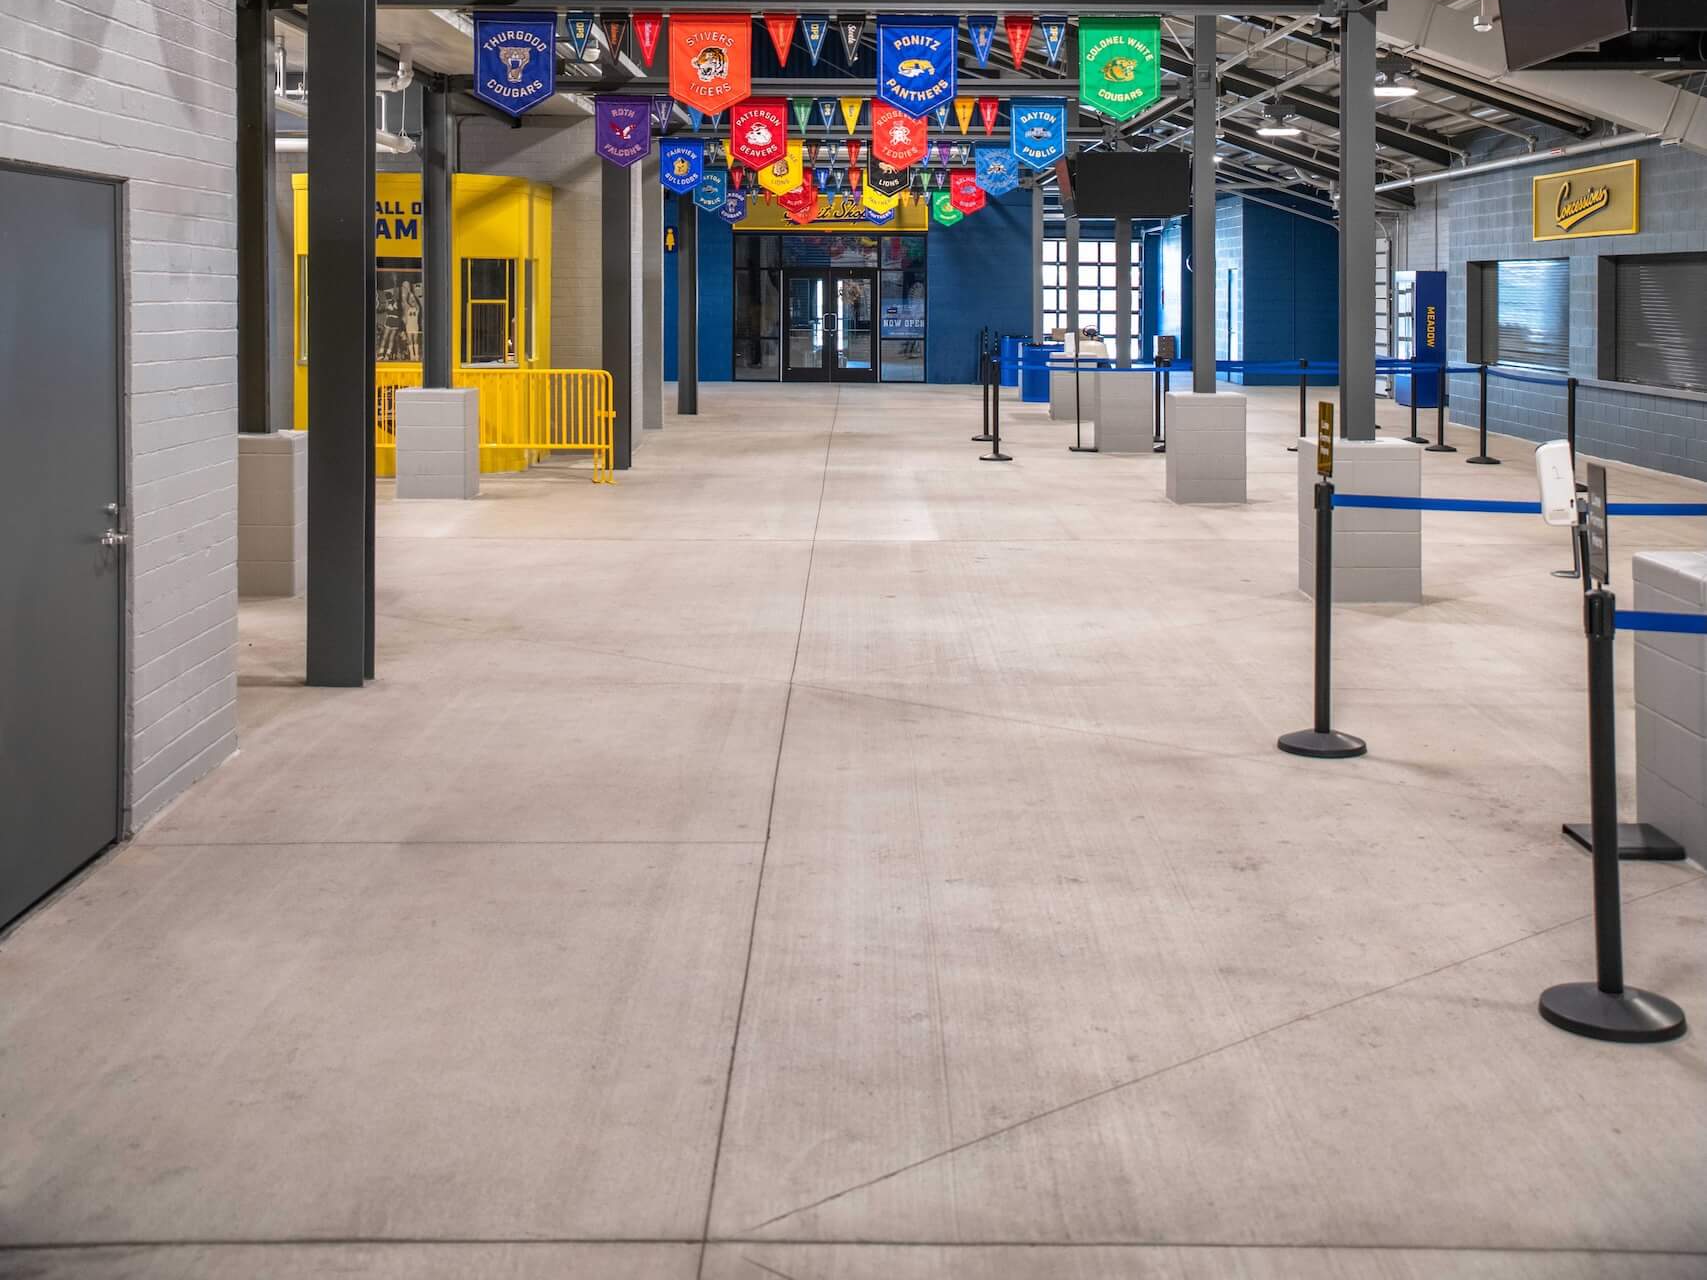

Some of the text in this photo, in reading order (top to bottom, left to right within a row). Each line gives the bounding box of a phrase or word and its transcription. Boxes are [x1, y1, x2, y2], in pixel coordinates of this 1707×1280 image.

[576, 22, 584, 39] DPS
[810, 23, 819, 40] DPS
[847, 23, 856, 45] Steele
[483, 30, 547, 52] THURGOOD
[686, 31, 735, 47] STIVERS
[893, 35, 942, 51] PONITZ
[1086, 36, 1154, 62] COLONEL WHITE
[487, 78, 543, 98] COUGARS
[689, 82, 732, 96] TIGERS
[886, 78, 949, 102] PANTHERS
[1098, 88, 1144, 102] COUGARS
[611, 108, 635, 118] ROTH
[736, 109, 782, 127] PATTERSON
[1020, 111, 1056, 124] DAYTON
[604, 143, 642, 157] FALCONS
[666, 148, 697, 160] FAIRVIEW
[739, 144, 778, 158] BEAVERS
[882, 146, 919, 159] TEDDIES
[1022, 145, 1056, 158] PUBLIC
[664, 173, 699, 186] BULLDOGS
[879, 179, 900, 187] LIONS
[376, 201, 422, 215] ALL O
[1555, 181, 1608, 223] Concessions
[376, 218, 417, 240] AM
[883, 319, 902, 328] NOW
[1426, 306, 1436, 348] MEADOW
